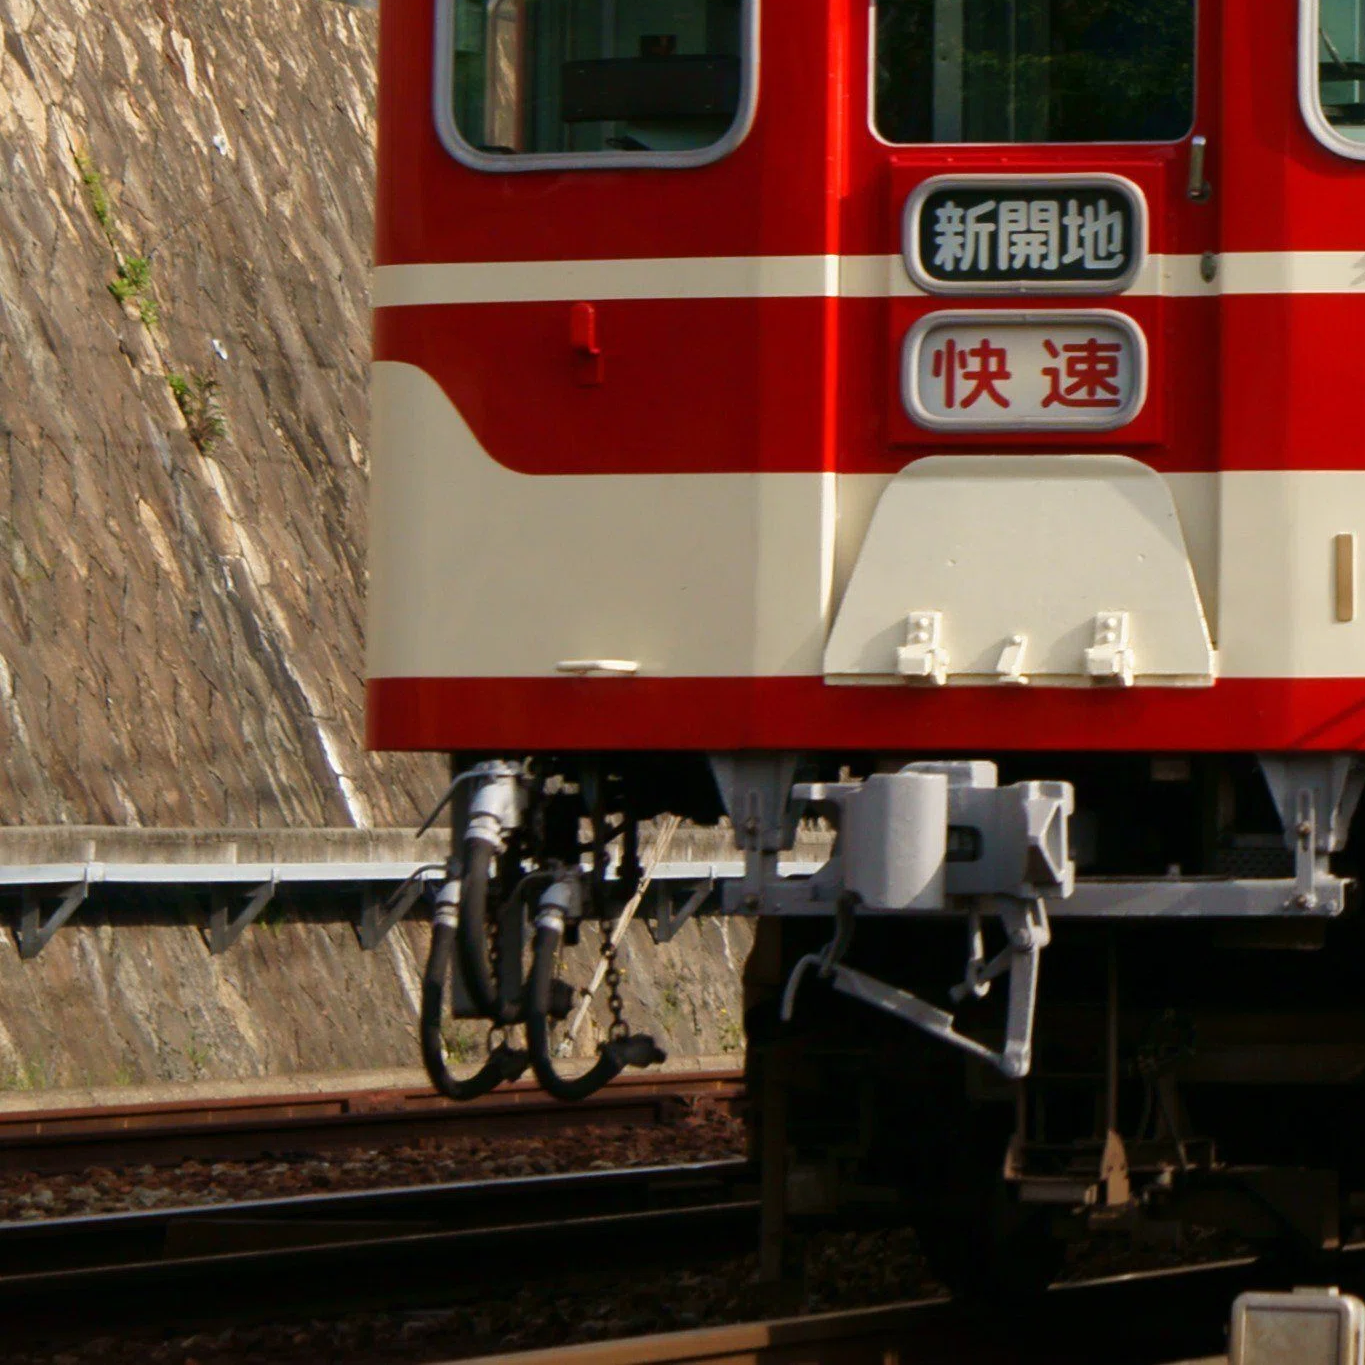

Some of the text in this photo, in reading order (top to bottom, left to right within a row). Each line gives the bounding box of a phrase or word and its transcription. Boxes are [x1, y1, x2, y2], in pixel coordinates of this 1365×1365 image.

[932, 199, 1124, 272] 新開地
[931, 338, 1122, 410] 快速
